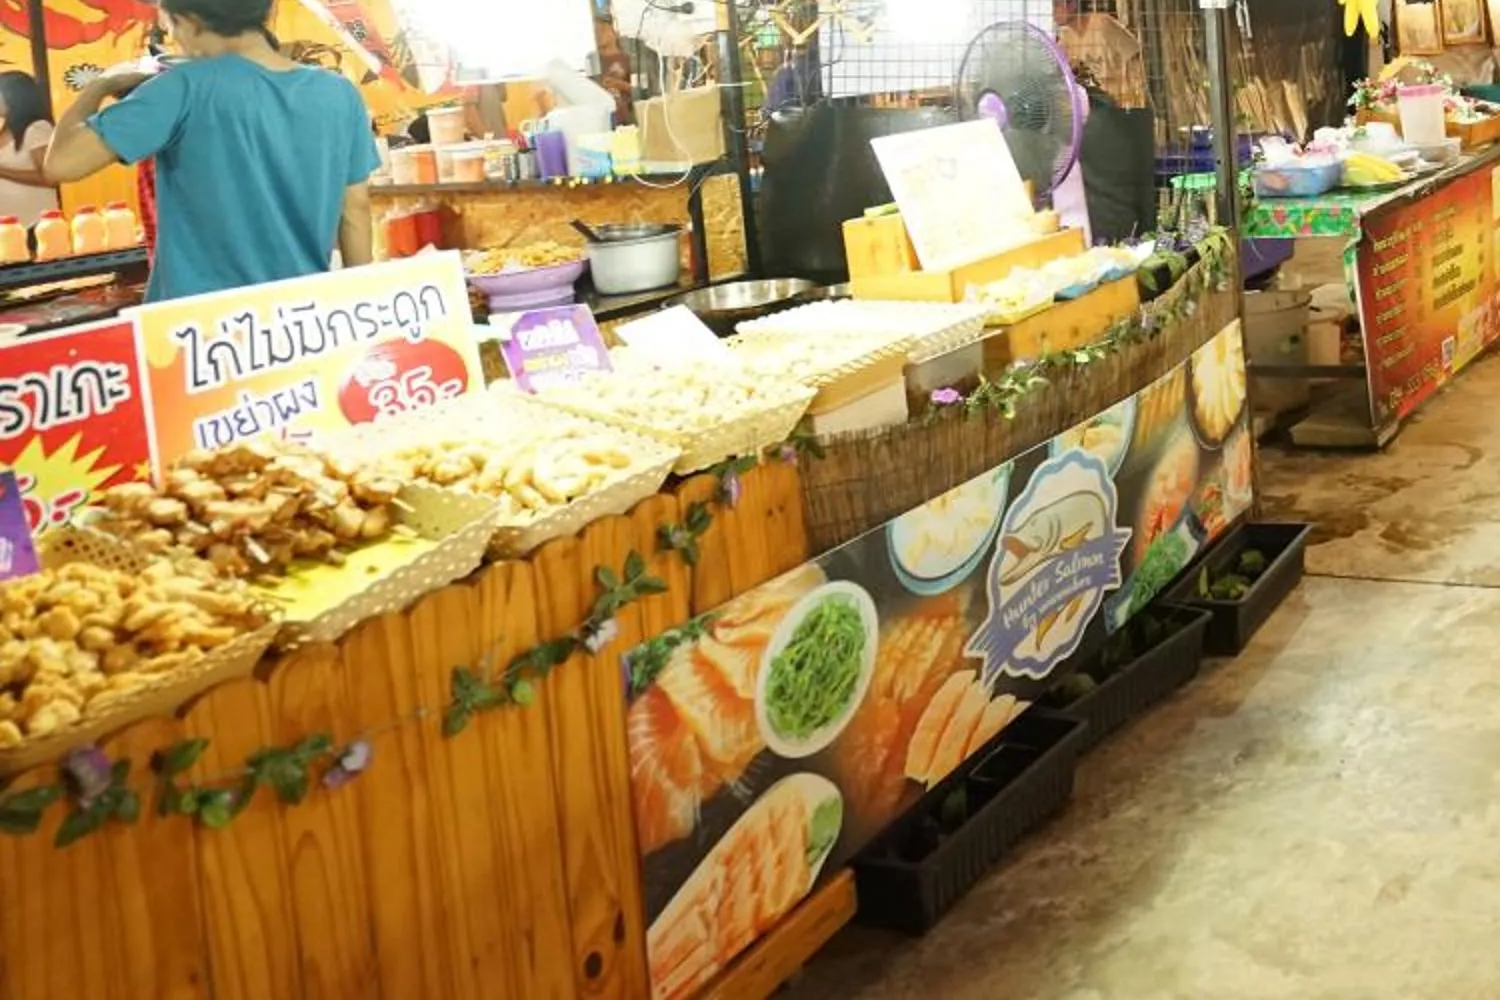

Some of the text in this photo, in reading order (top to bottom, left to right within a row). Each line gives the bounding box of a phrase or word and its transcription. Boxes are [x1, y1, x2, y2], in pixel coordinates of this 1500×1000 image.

[176, 284, 446, 388] ไก่ไม่มีกระดูก
[1054, 551, 1105, 584] Salmon
